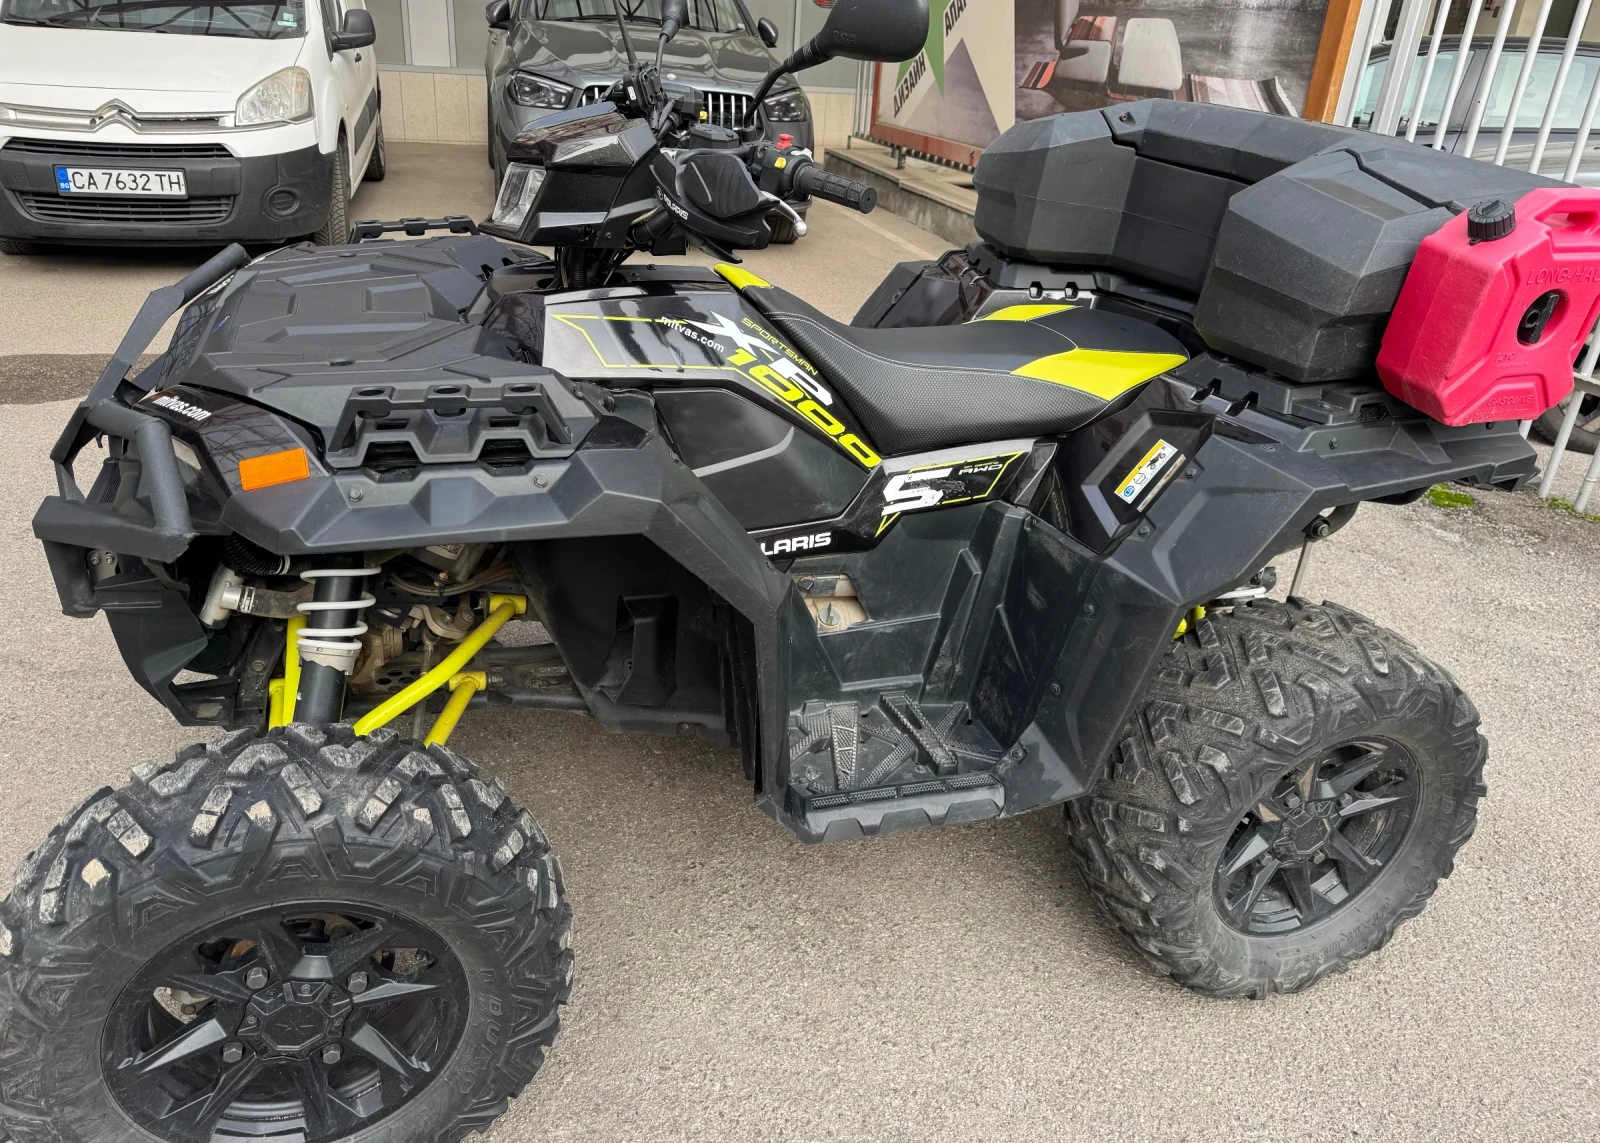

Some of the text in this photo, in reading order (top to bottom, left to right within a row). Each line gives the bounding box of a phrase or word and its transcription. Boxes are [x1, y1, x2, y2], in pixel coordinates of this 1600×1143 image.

[893, 51, 926, 118] ДИЗАЙН
[71, 171, 182, 192] CA 7632 TH
[660, 315, 725, 354] mitvas.com
[740, 316, 819, 377] SPORTSMAN
[725, 347, 883, 468] 1000
[1487, 394, 1534, 407] GASOLINE
[958, 463, 1004, 476] AWD
